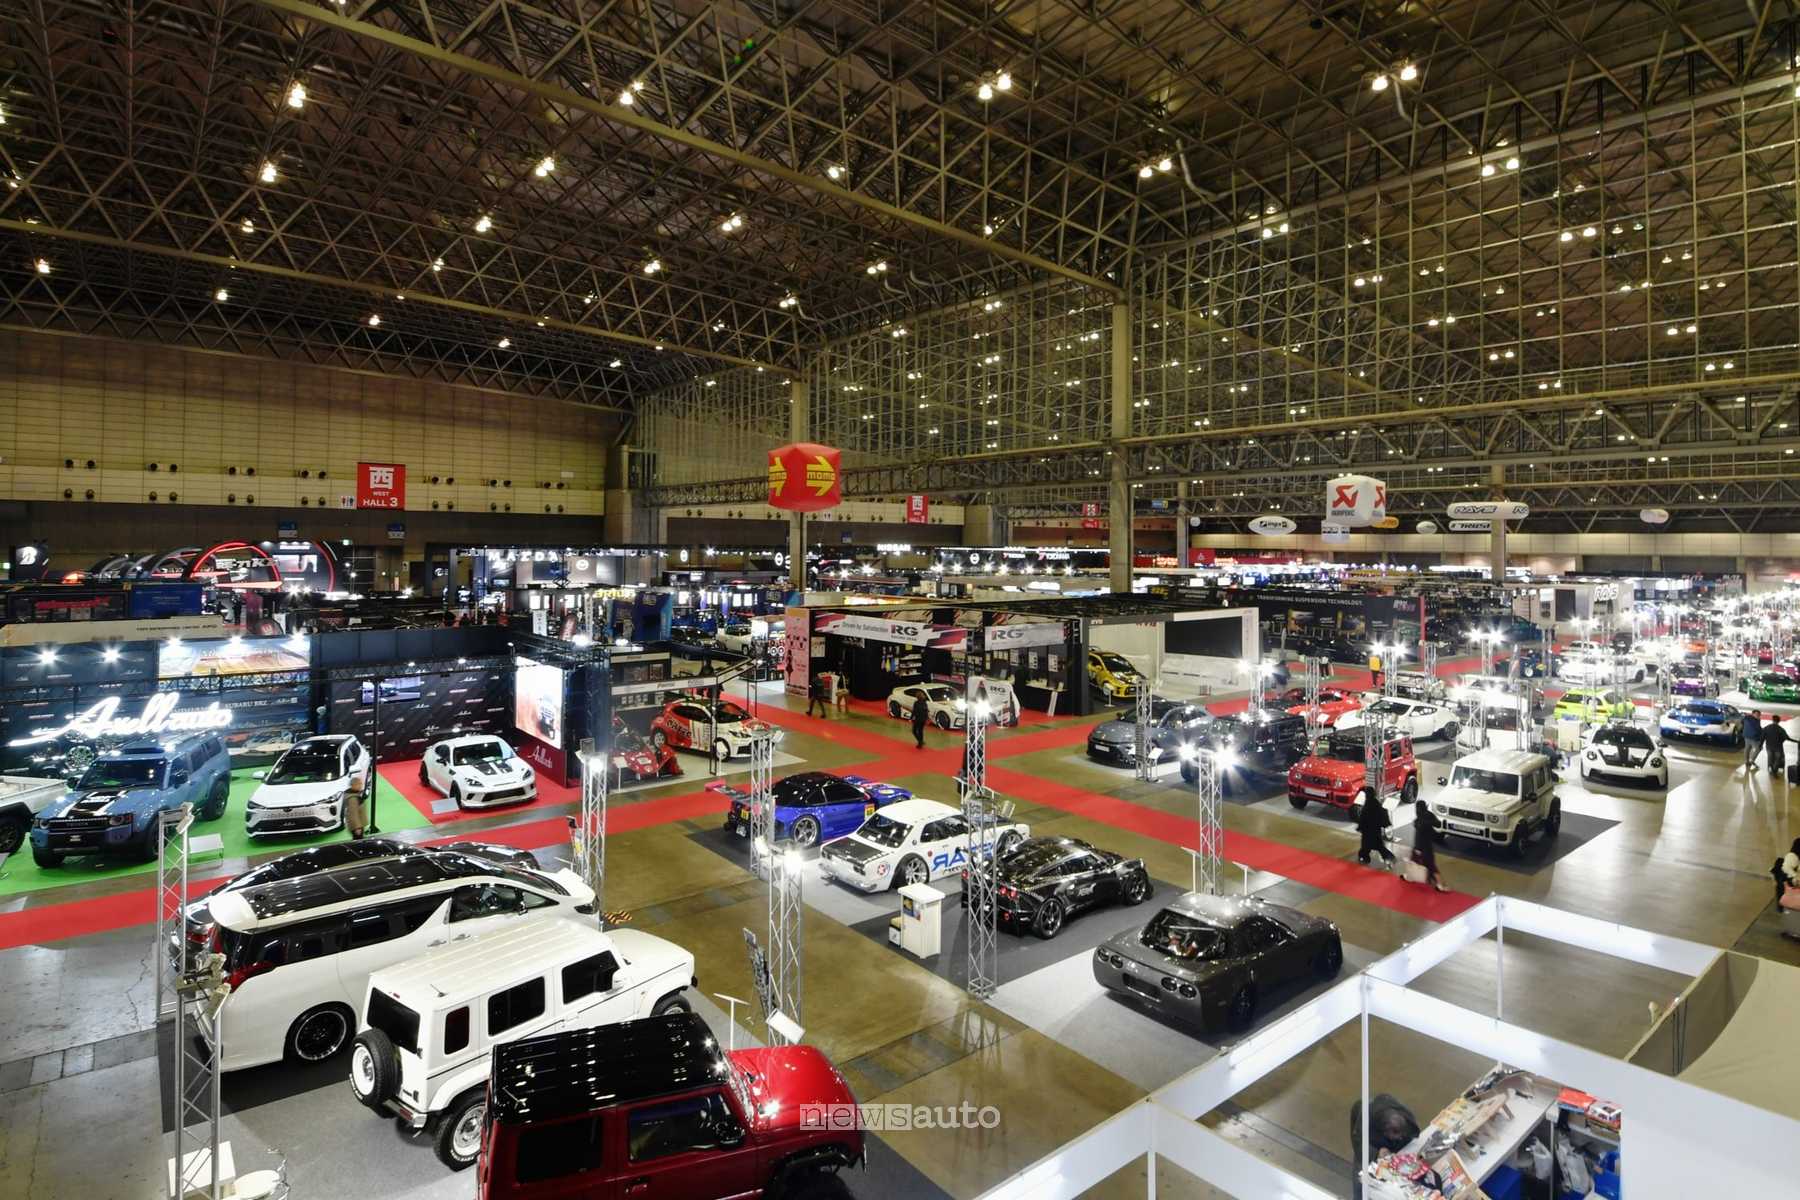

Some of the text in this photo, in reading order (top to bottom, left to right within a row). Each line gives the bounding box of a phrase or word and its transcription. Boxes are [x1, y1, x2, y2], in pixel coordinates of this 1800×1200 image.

[369, 467, 394, 489] 西
[363, 497, 398, 507] HALL 3
[488, 550, 558, 562] MAZDA
[891, 624, 918, 636] RG
[992, 629, 1024, 640] RG
